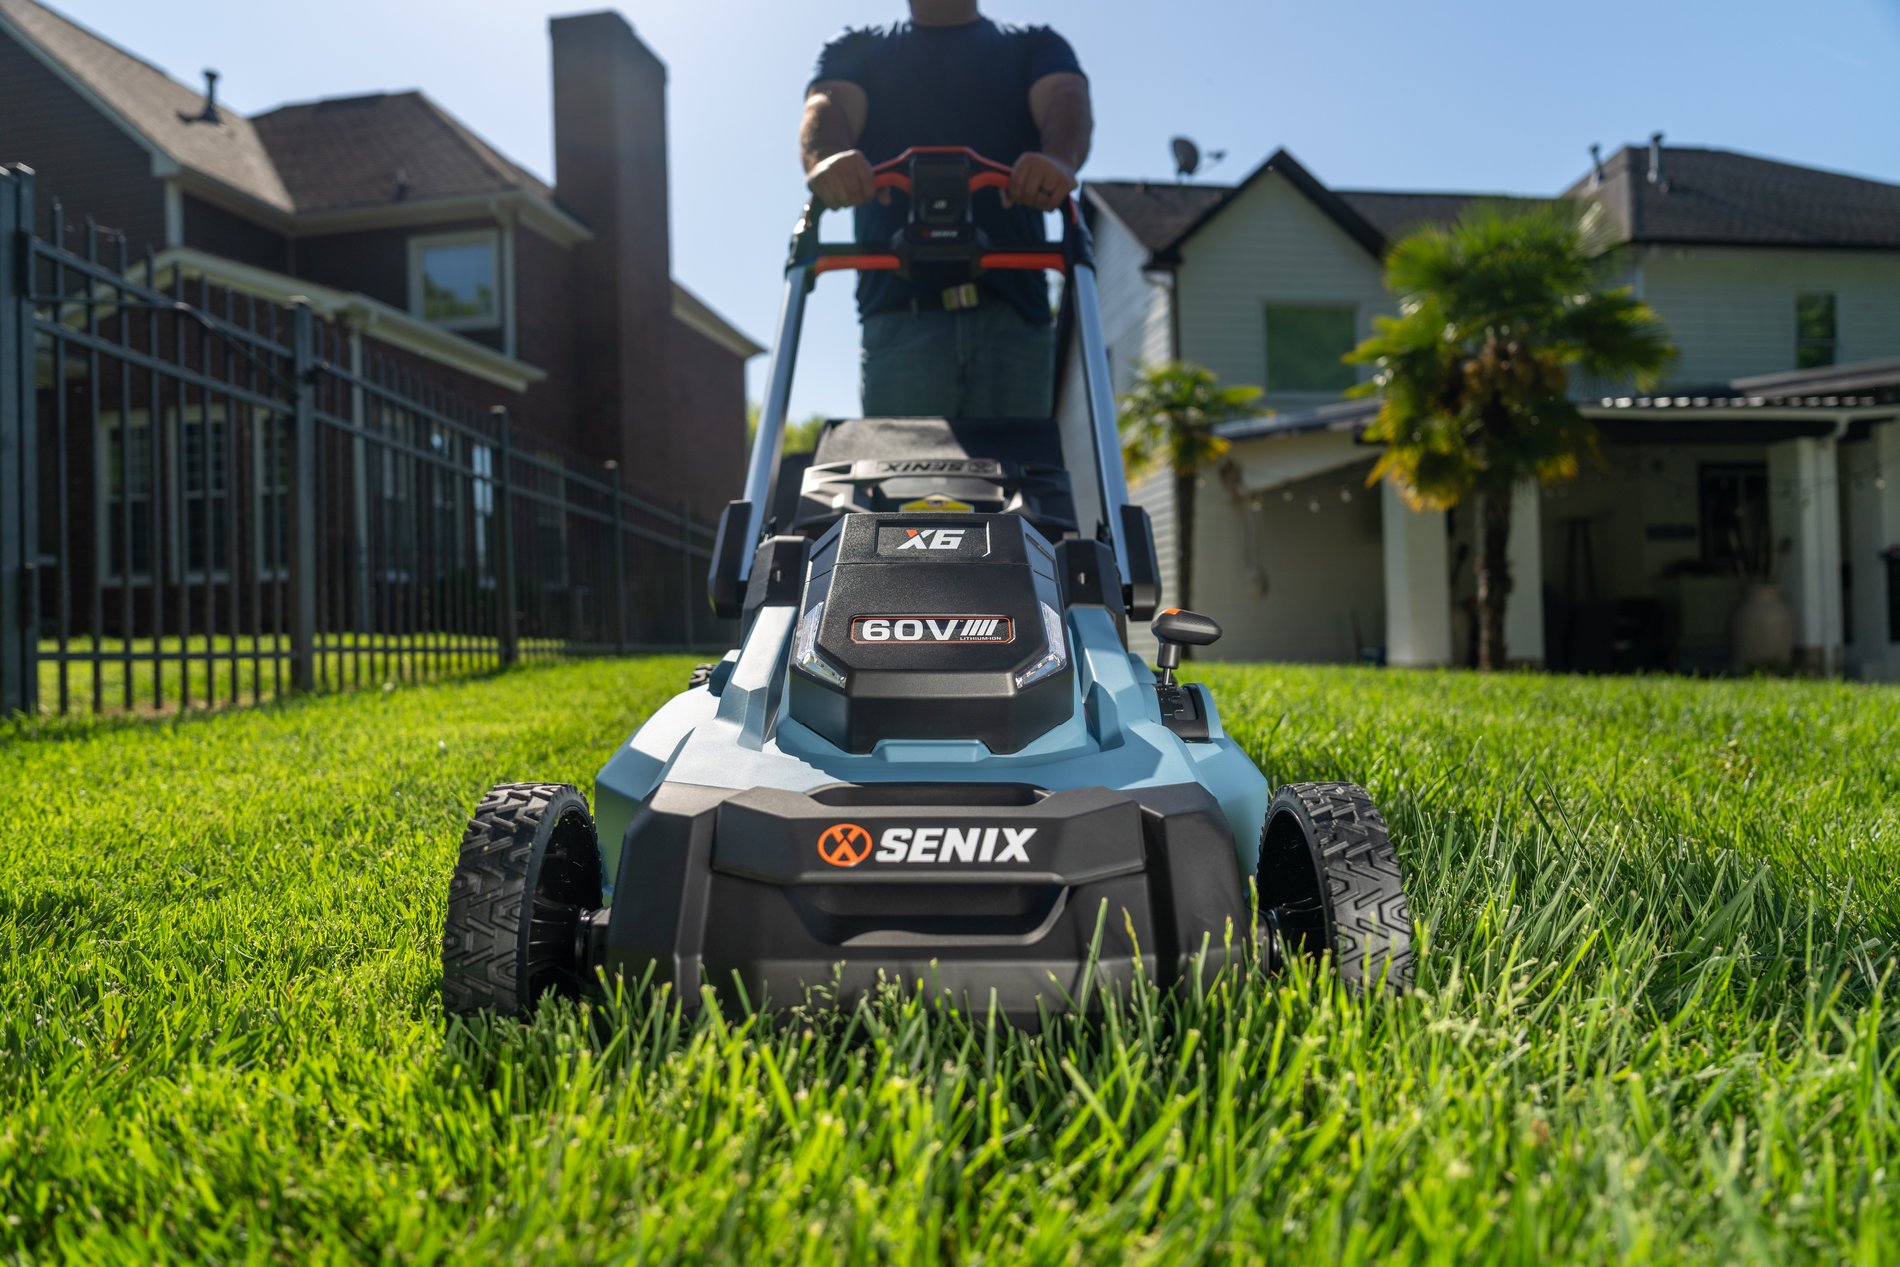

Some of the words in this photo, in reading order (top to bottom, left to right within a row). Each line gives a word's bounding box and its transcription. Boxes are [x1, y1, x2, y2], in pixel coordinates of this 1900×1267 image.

[896, 529, 966, 549] X6
[862, 619, 960, 641] 60V
[875, 828, 1037, 862] SENIX
